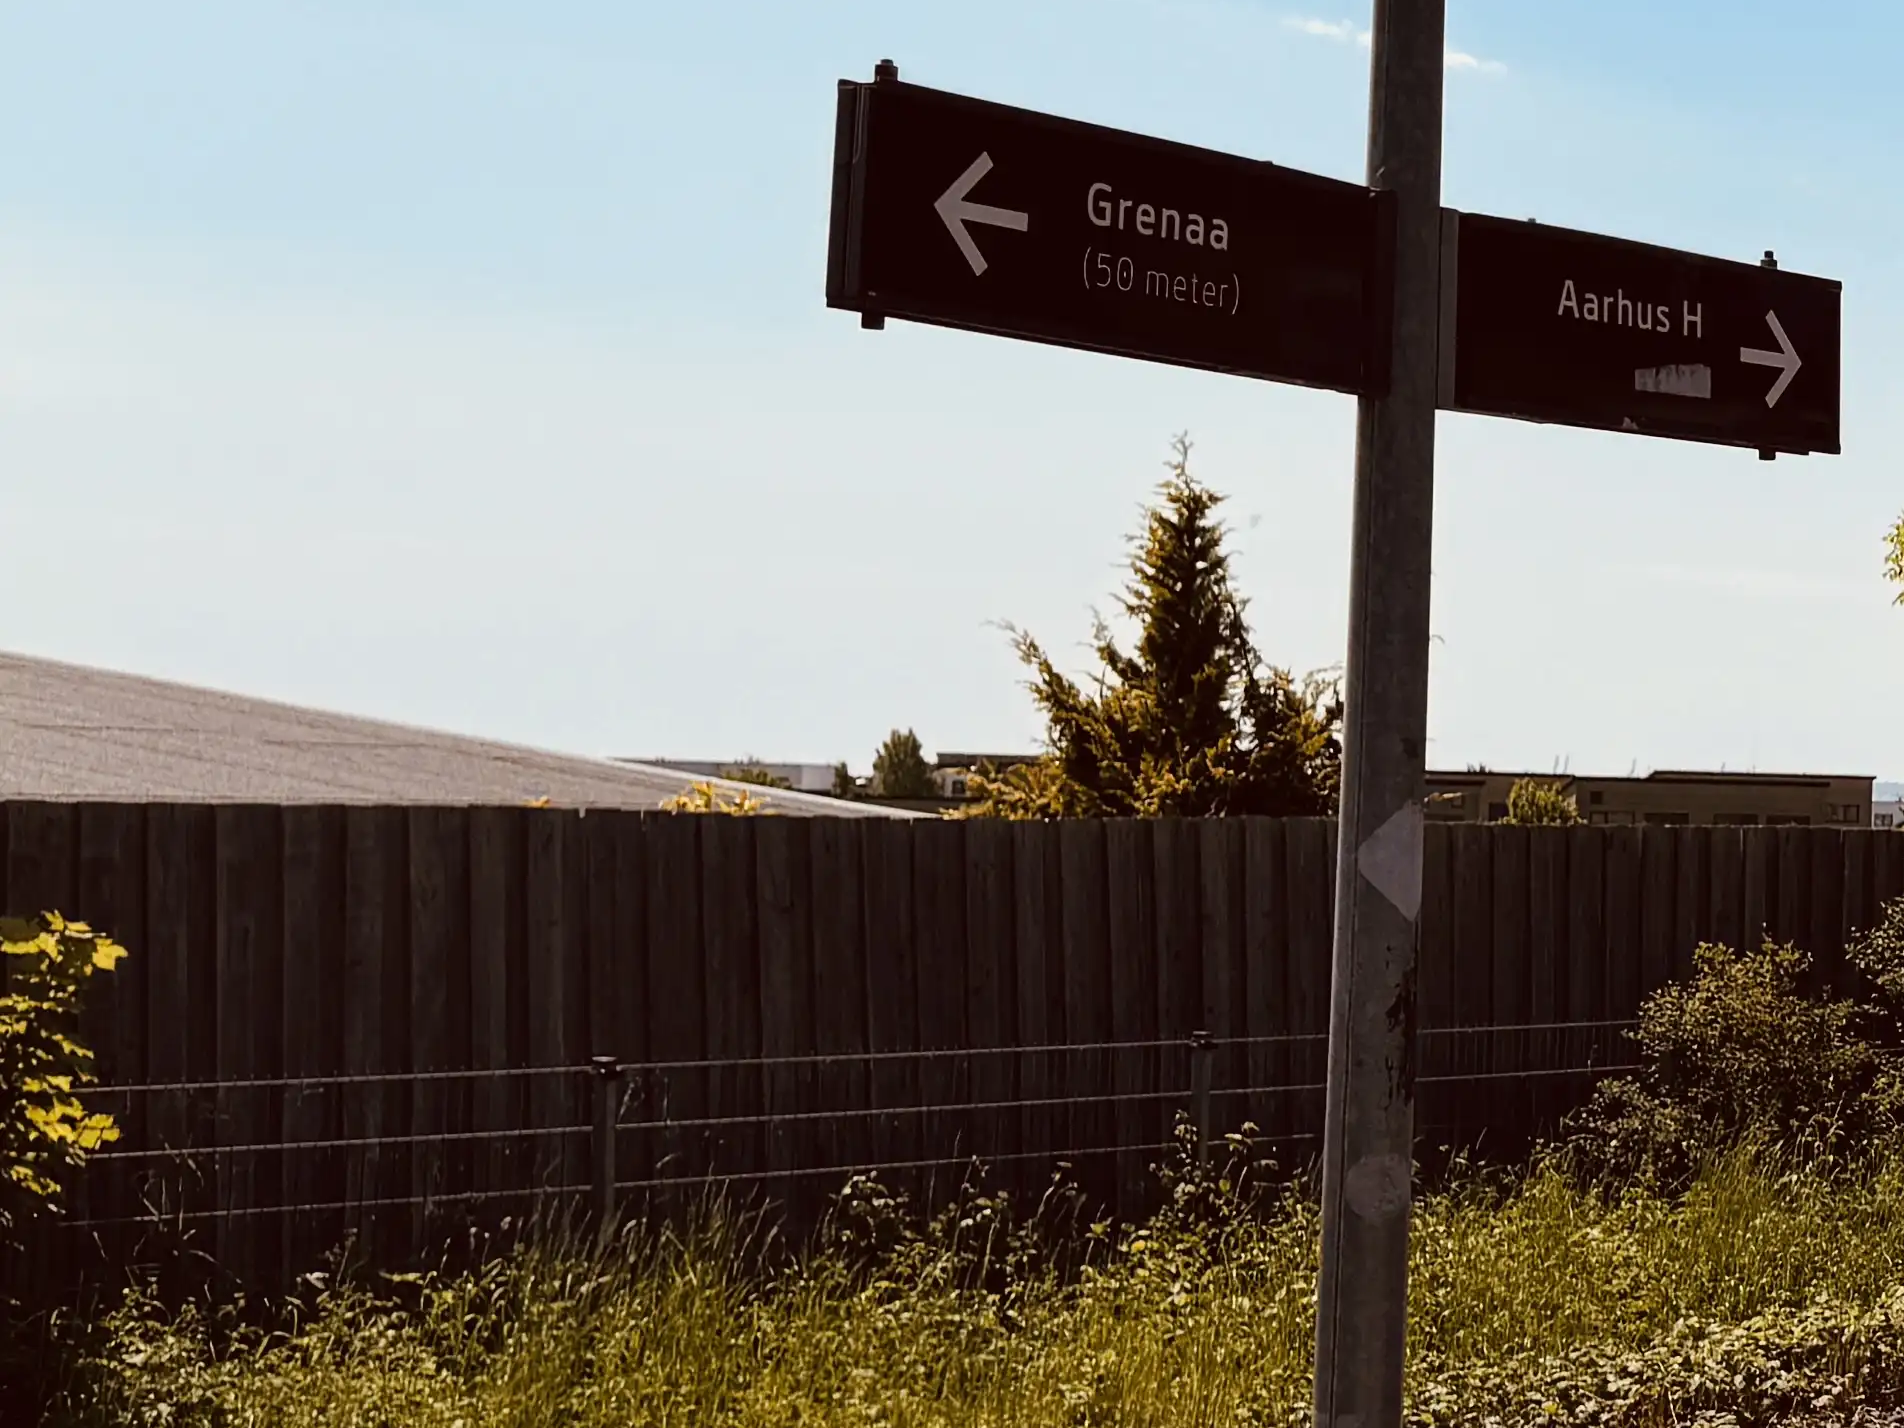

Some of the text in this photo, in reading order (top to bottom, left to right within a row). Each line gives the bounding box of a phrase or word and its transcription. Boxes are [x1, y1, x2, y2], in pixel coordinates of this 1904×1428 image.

[1087, 182, 1229, 252] Grenaa
[1083, 246, 1240, 315] (50 meter)
[1557, 279, 1702, 338] Aarhus H
